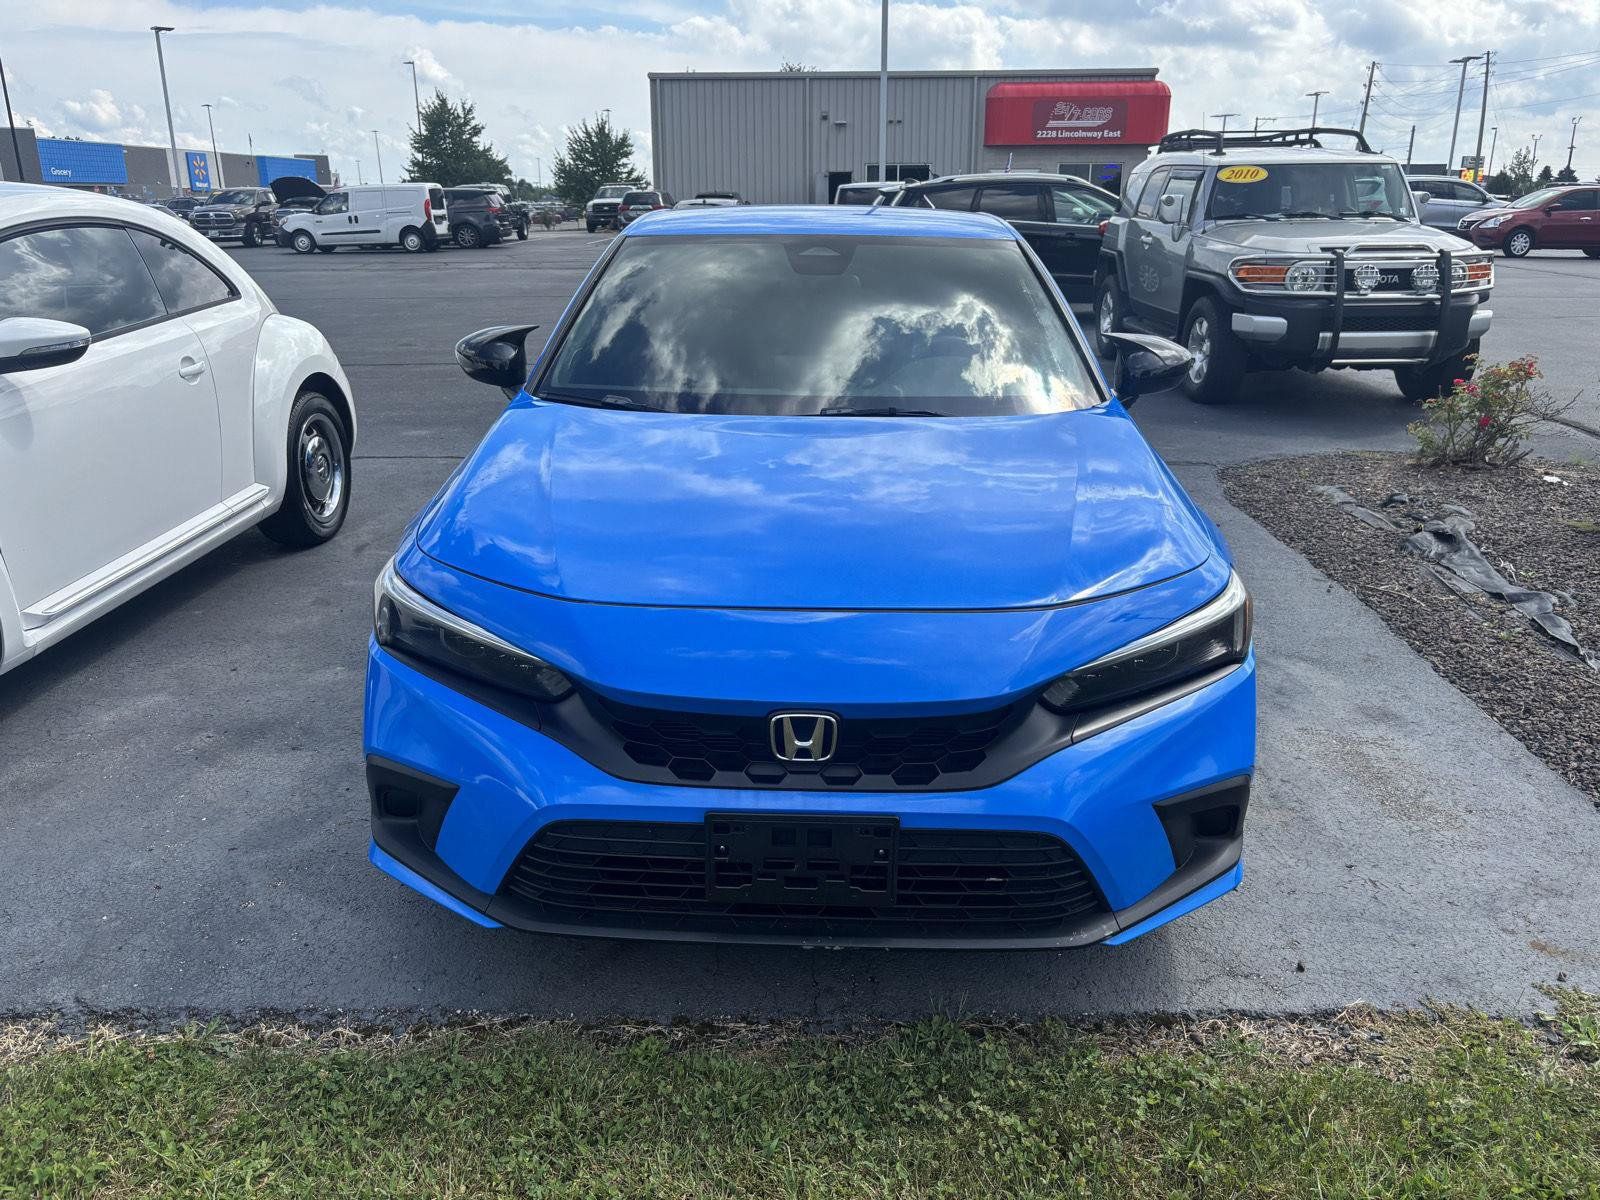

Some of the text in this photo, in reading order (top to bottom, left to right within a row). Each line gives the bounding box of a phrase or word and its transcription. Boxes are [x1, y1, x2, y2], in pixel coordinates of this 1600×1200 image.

[1037, 130, 1121, 139] 2228 Lincolnway East
[50, 167, 72, 177] Grocery
[1225, 169, 1260, 180] 2010
